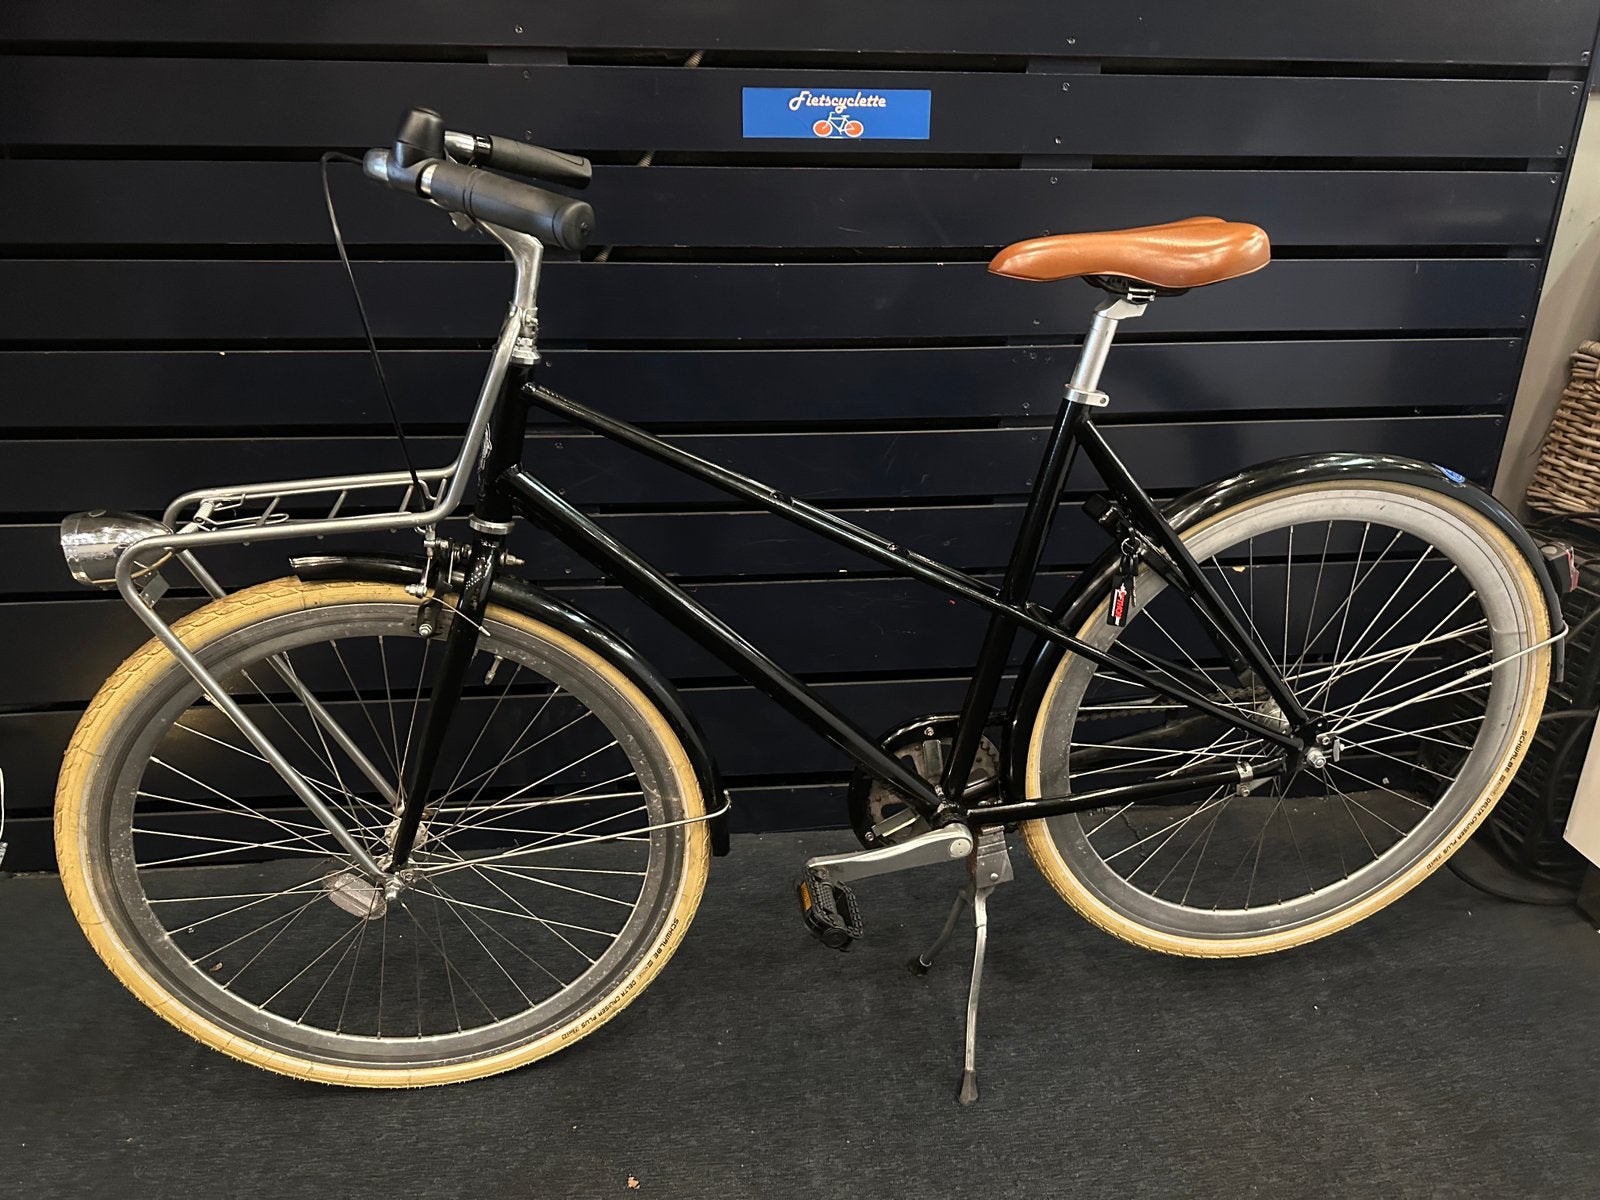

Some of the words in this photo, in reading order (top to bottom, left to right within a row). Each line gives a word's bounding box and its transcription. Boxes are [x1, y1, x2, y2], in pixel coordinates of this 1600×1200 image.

[788, 90, 887, 114] Fietscyclette
[1504, 729, 1528, 773] SCHWALBE
[1477, 797, 1492, 816] DELTA
[1457, 816, 1478, 840] CRUISER
[1442, 840, 1458, 855] PLUS
[653, 917, 680, 959] SCHWALBE
[621, 979, 637, 997] DELTA
[598, 995, 621, 1017] CRUISER
[581, 1016, 598, 1029] PLUS
